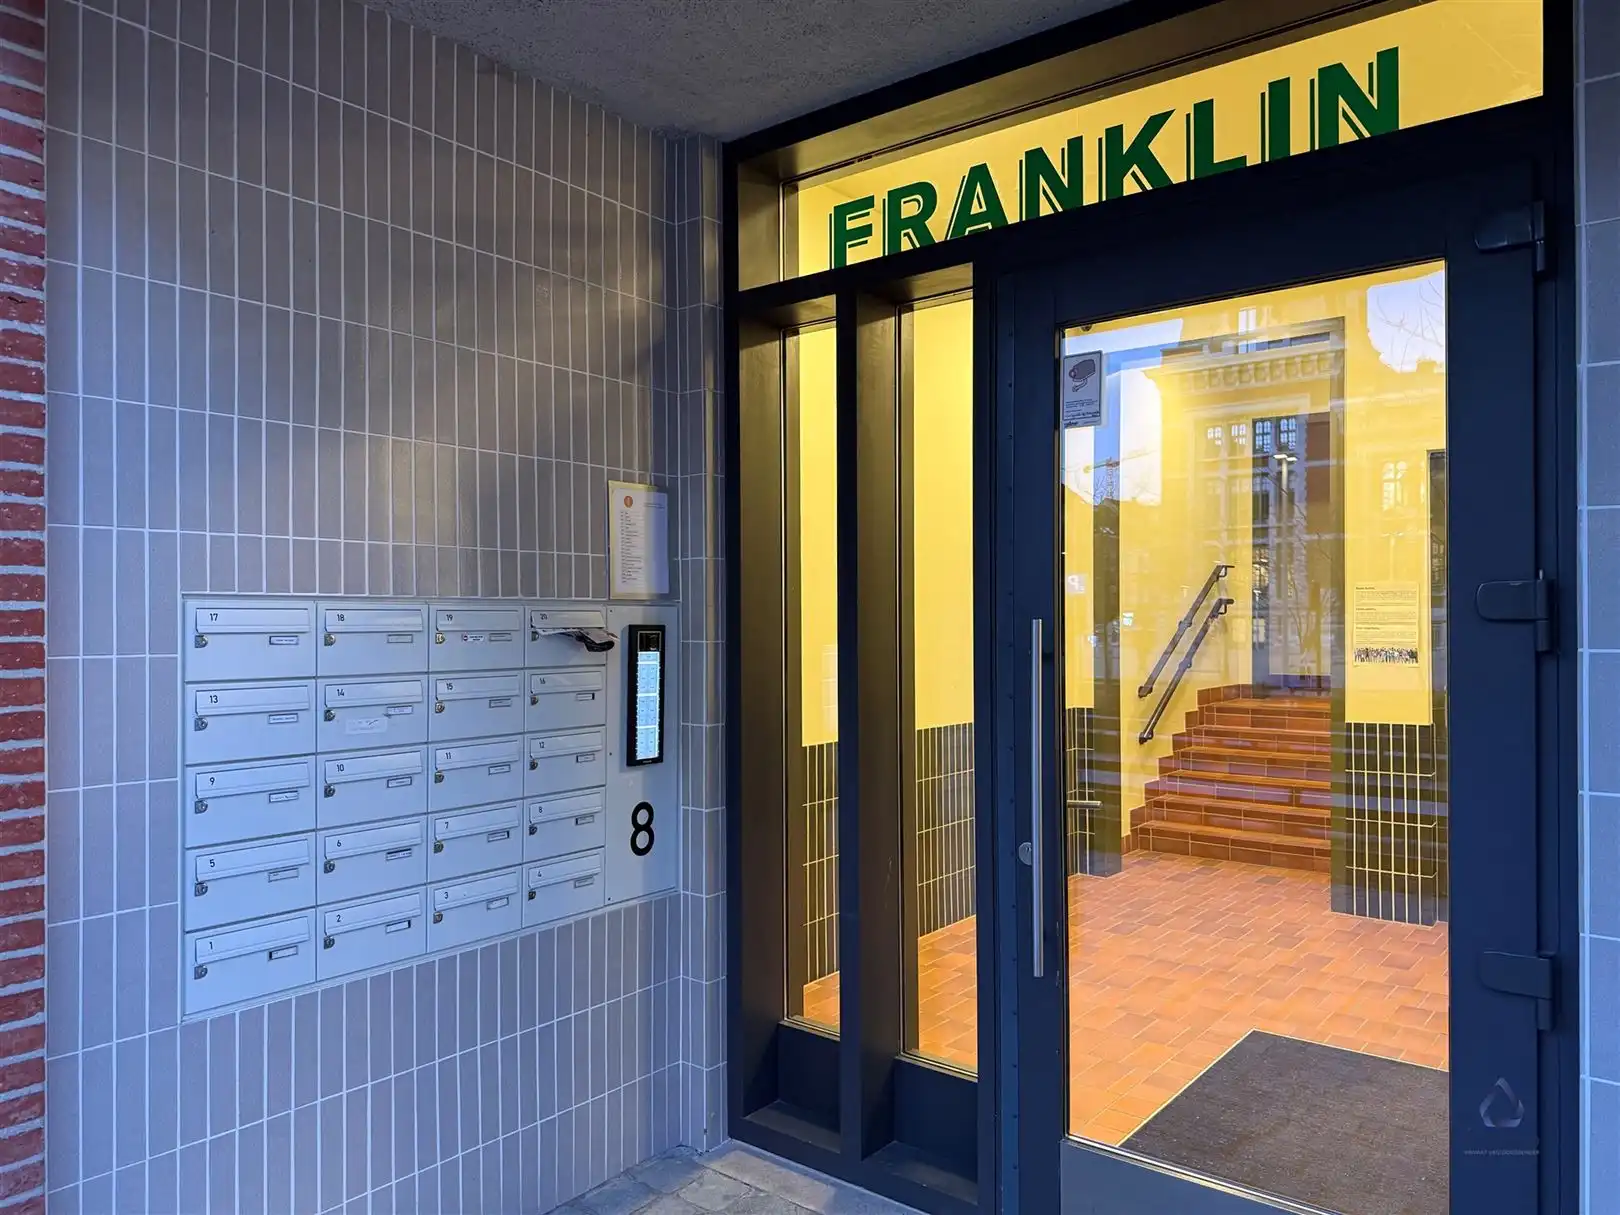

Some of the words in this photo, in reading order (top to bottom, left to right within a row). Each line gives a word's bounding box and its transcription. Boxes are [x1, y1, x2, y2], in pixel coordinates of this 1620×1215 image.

[829, 46, 1400, 270] FRANKLIN
[209, 613, 219, 622] 17
[336, 613, 345, 622] 18
[445, 613, 454, 621] 19
[539, 677, 546, 685] 16
[445, 683, 454, 691] 15
[336, 688, 345, 697] 14
[209, 694, 219, 704] 13
[538, 741, 546, 749] 12
[445, 751, 452, 760] 11
[336, 763, 345, 773] 10
[630, 801, 655, 857] 8
